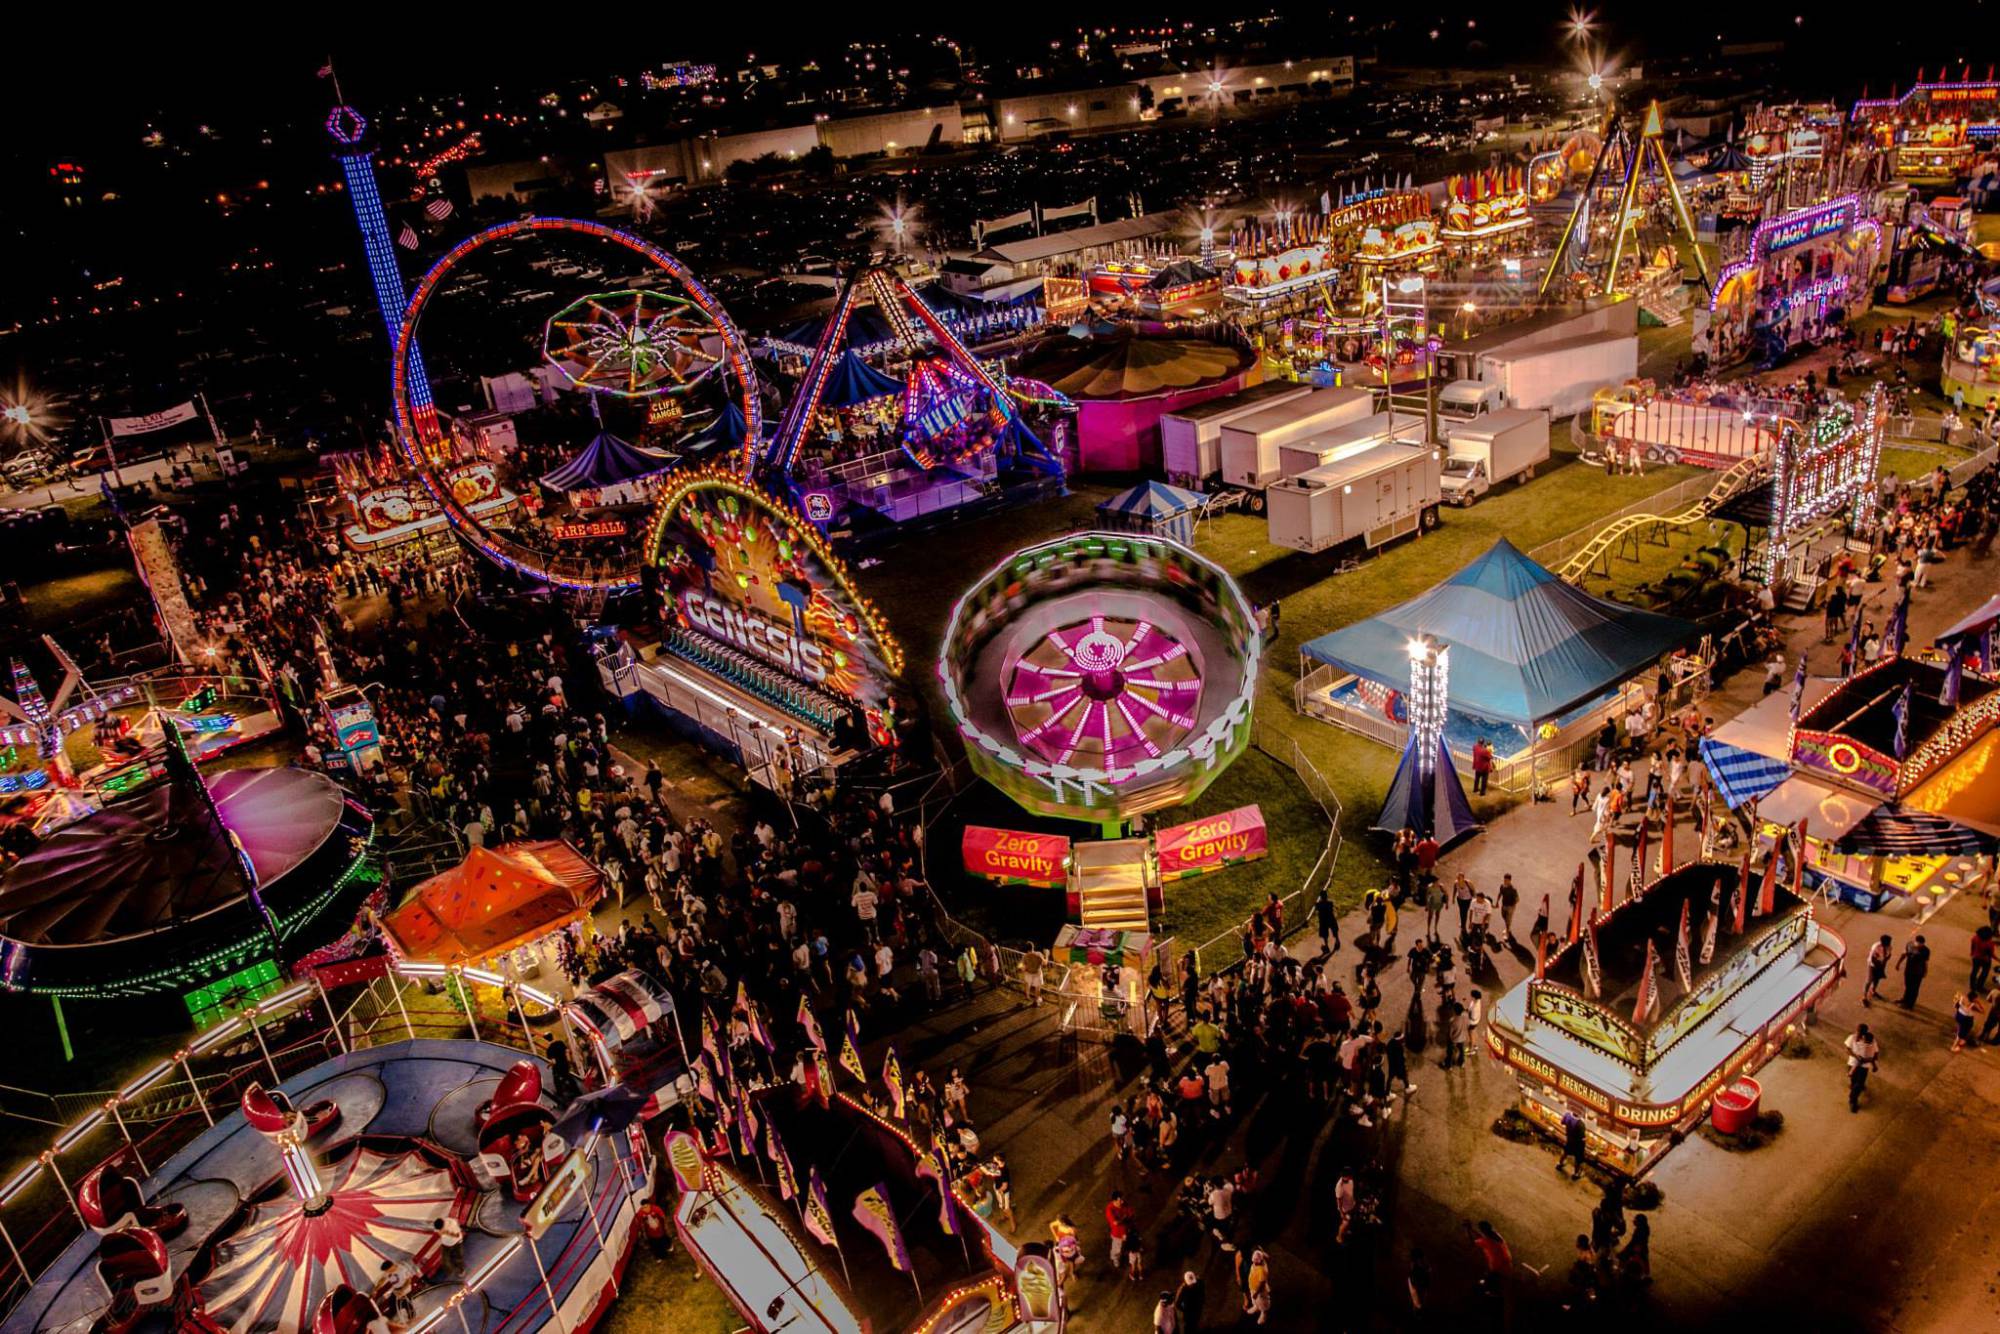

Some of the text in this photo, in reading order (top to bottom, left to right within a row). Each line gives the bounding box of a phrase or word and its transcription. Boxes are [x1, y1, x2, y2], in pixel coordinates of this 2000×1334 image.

[1771, 208, 1845, 250] MAGIC MAZE
[650, 407, 682, 421] HANGER
[652, 399, 676, 411] CLIFF
[592, 521, 624, 535] BALL
[686, 592, 826, 681] GENESIS
[1184, 820, 1231, 842] Zero
[995, 832, 1039, 853] Zero
[1180, 832, 1249, 861] Gravity
[985, 850, 1053, 875] Gravity
[1537, 994, 1629, 1057] STEAK
[1511, 1048, 1556, 1081] SAUSAGE
[1562, 1075, 1587, 1097] FRENCH
[1618, 1105, 1678, 1122] DRINKS
